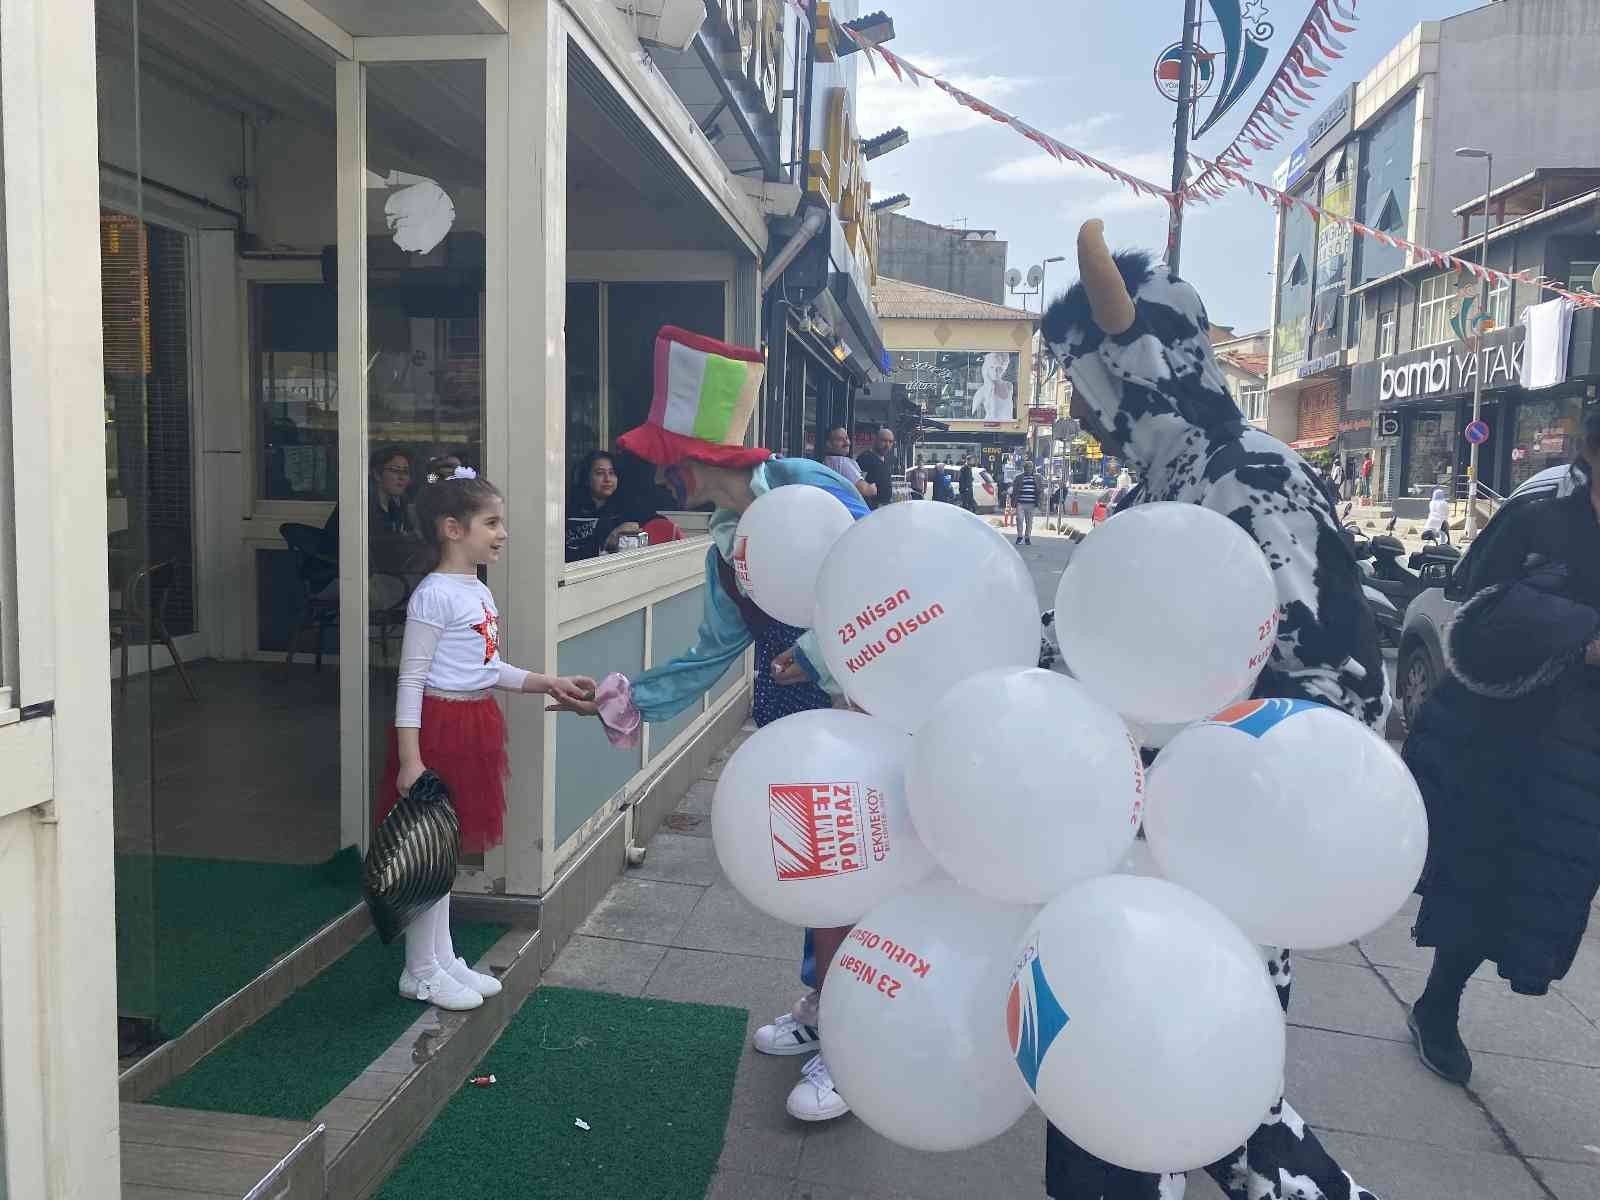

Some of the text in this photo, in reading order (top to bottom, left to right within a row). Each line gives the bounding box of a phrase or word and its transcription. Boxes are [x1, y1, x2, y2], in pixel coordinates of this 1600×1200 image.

[1379, 345, 1452, 401] bambi
[1456, 342, 1524, 387] YATAK
[838, 586, 912, 646] 23 Nisan
[845, 601, 945, 674] Kutlu Olsun
[812, 787, 840, 871] AHMET
[833, 785, 859, 871] POYRAZ
[840, 953, 904, 999] 23 Nisan
[883, 939, 933, 978] Kutlu
